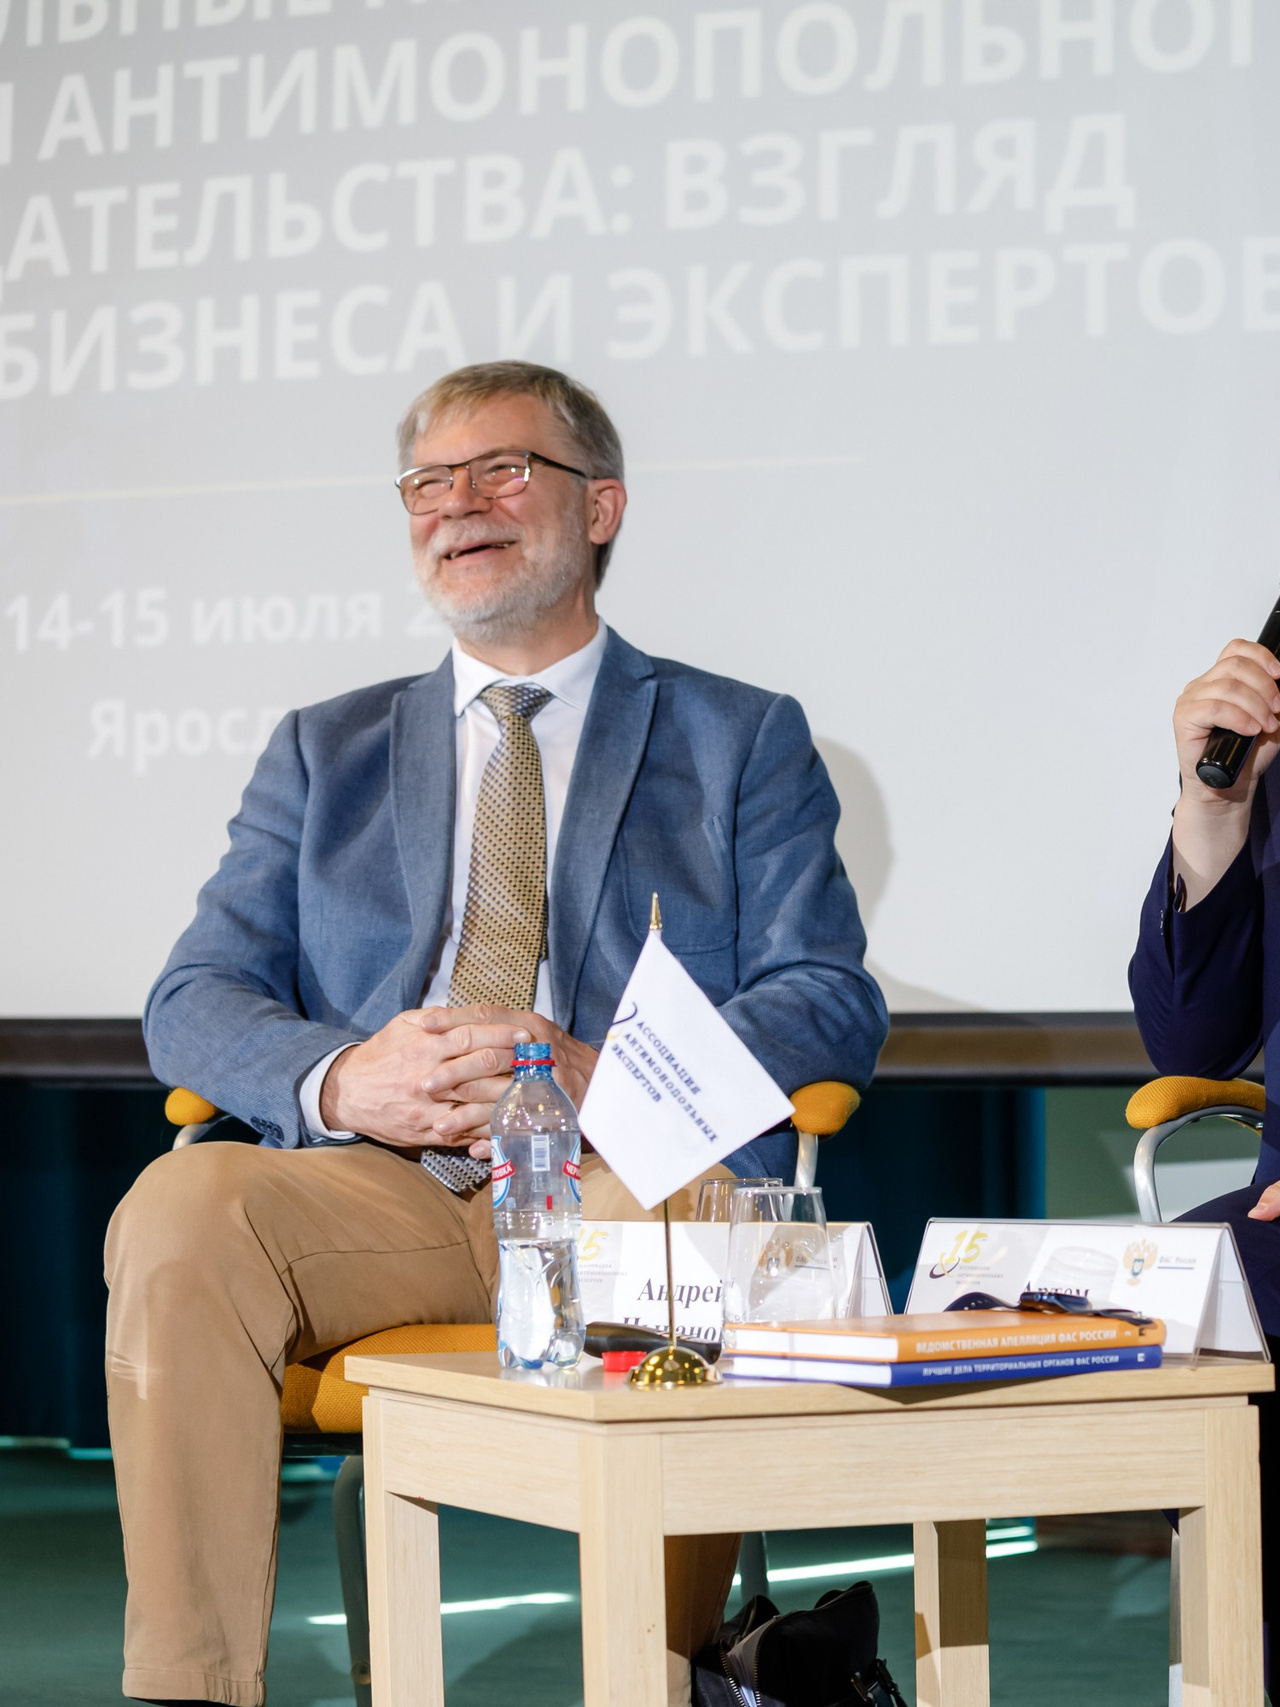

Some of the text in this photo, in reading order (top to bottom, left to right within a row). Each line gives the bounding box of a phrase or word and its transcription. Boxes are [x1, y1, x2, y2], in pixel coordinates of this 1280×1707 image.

[0, 111, 1137, 282] АТЕЛЬСТВА: ВЗГЛЯД
[0, 280, 468, 400] БИЗНЕСА
[499, 272, 572, 363] И
[5, 587, 170, 653] 14-15
[191, 590, 383, 645] июля
[86, 697, 289, 777] Яросл
[953, 1364, 973, 1375] ДЕЛА
[1043, 1358, 1075, 1368] ОРГАНОВ
[1076, 1357, 1090, 1366] ФАС
[1091, 1355, 1120, 1365] РОССИИ
[1000, 1333, 1057, 1347] АПЕЛЛЯЦИЯ
[1058, 1331, 1078, 1343] ФАС
[1079, 1329, 1117, 1341] РОССИИ
